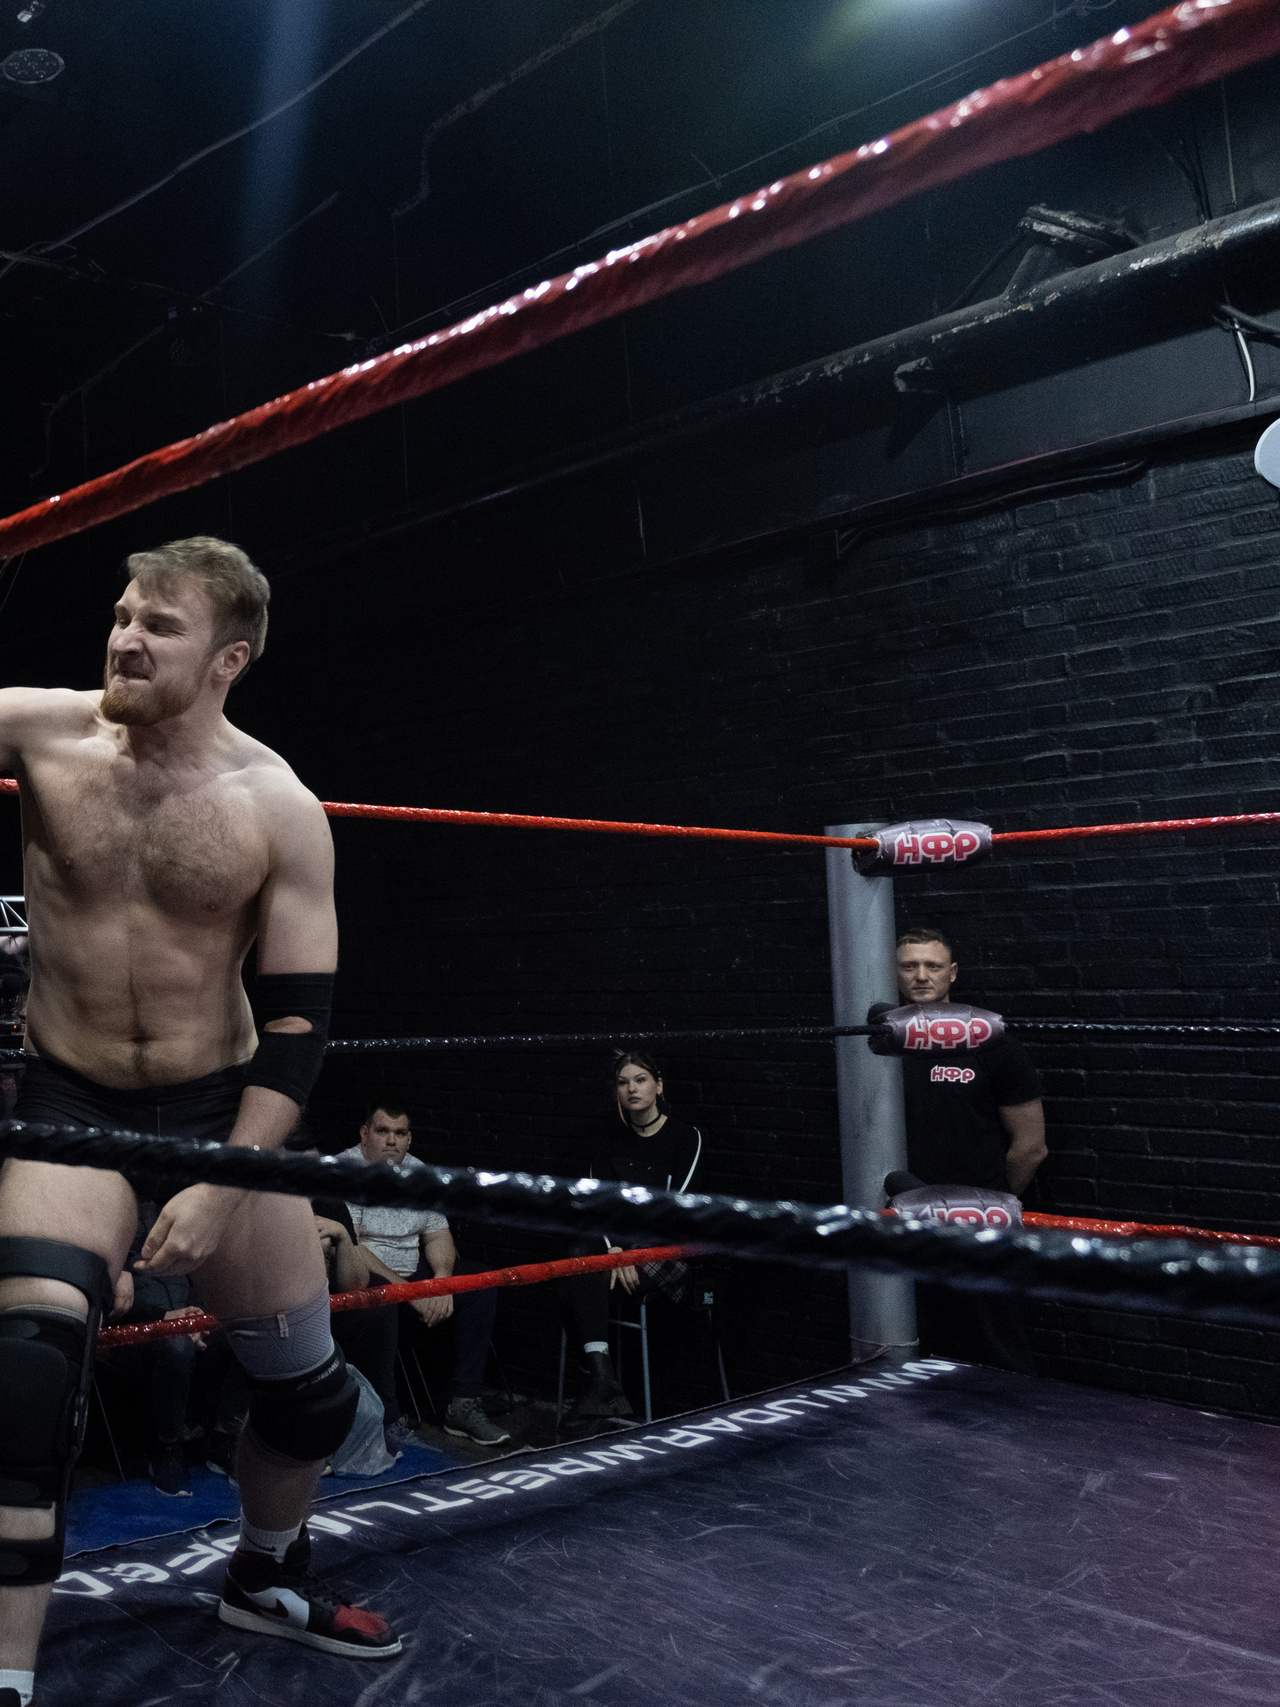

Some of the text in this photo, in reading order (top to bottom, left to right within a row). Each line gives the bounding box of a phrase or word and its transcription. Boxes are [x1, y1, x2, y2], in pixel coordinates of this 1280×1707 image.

[893, 830, 980, 865] НФР
[903, 1016, 992, 1050] НФР
[930, 1064, 976, 1084] НФР
